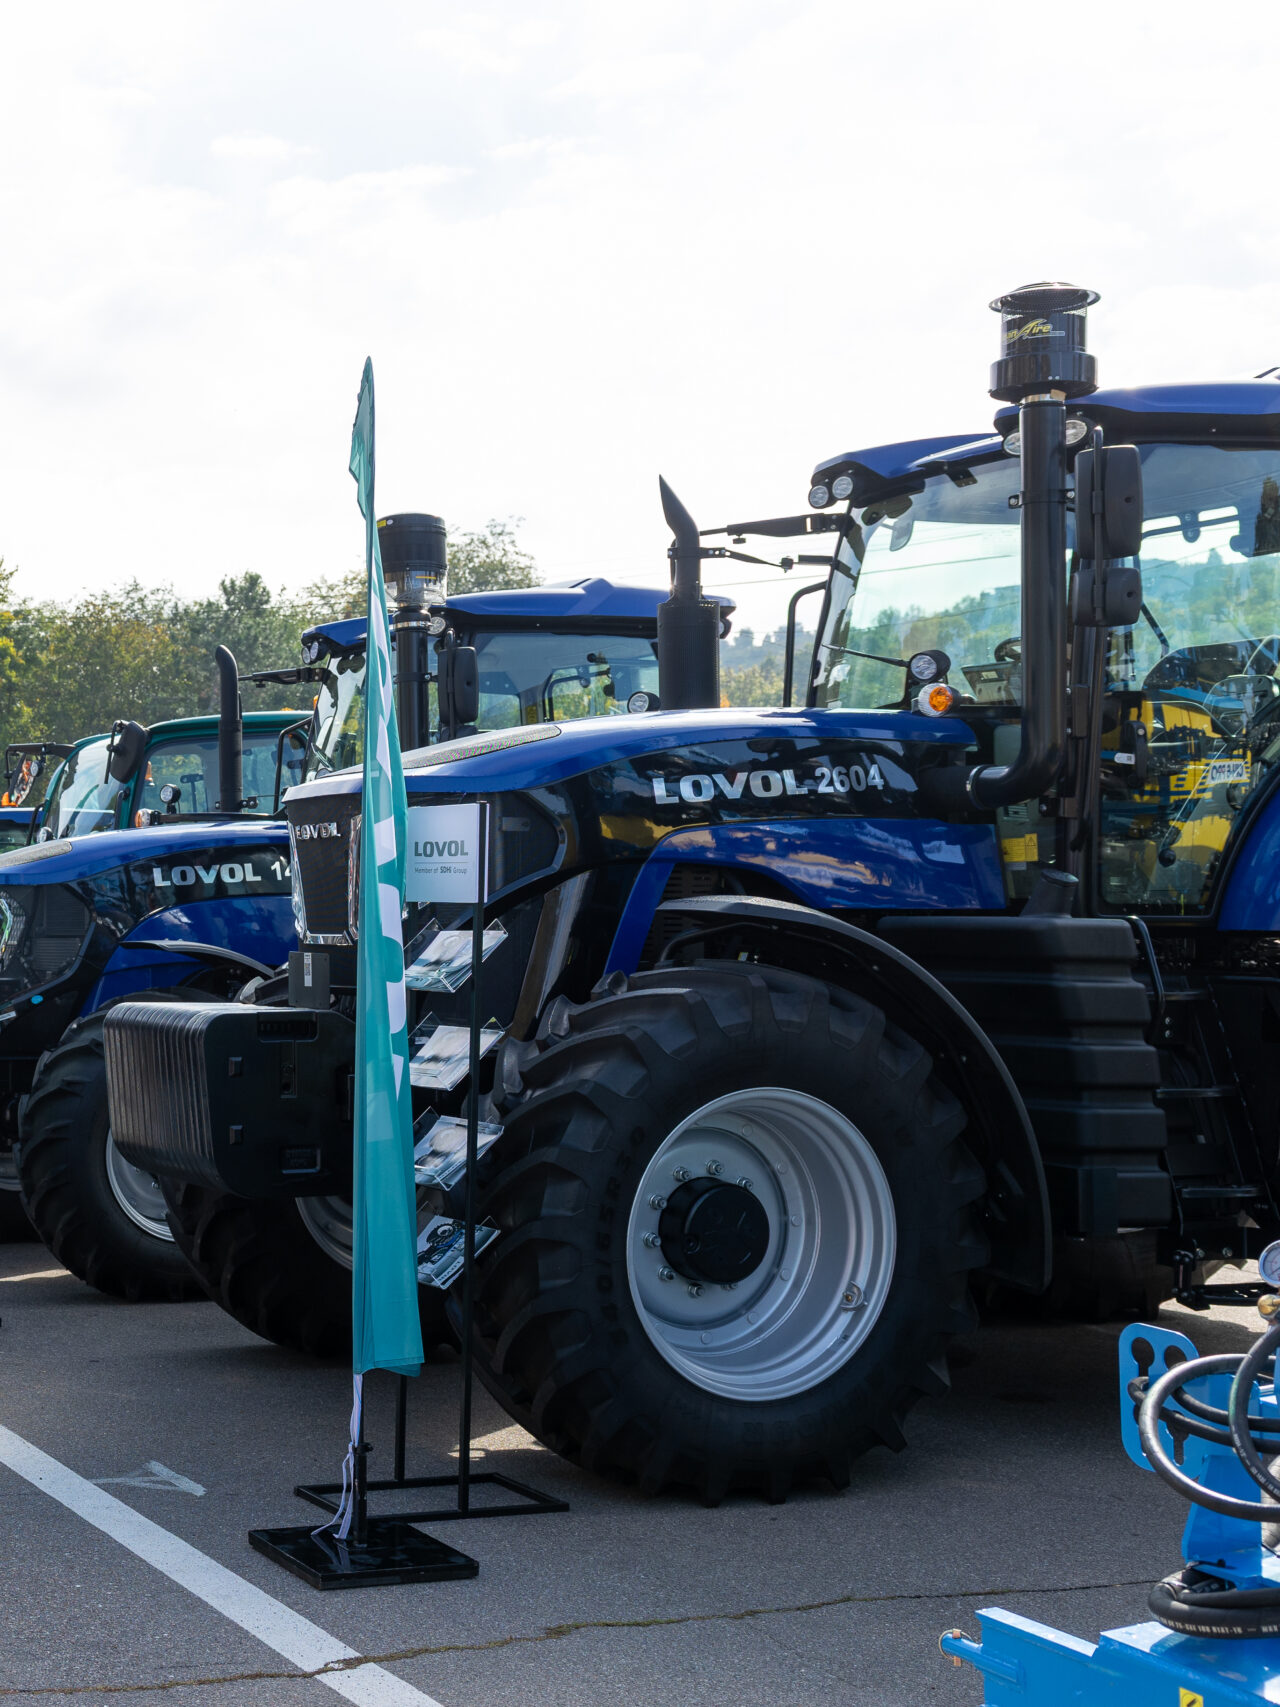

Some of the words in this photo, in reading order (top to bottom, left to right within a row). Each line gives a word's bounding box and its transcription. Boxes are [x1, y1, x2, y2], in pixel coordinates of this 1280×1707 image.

[652, 769, 808, 805] LOVOL
[814, 763, 885, 794] 2604
[294, 822, 341, 840] LOVOL
[414, 840, 468, 857] LOVOL
[152, 862, 262, 887] LOVOL
[414, 866, 432, 874] Member
[453, 867, 467, 875] Group
